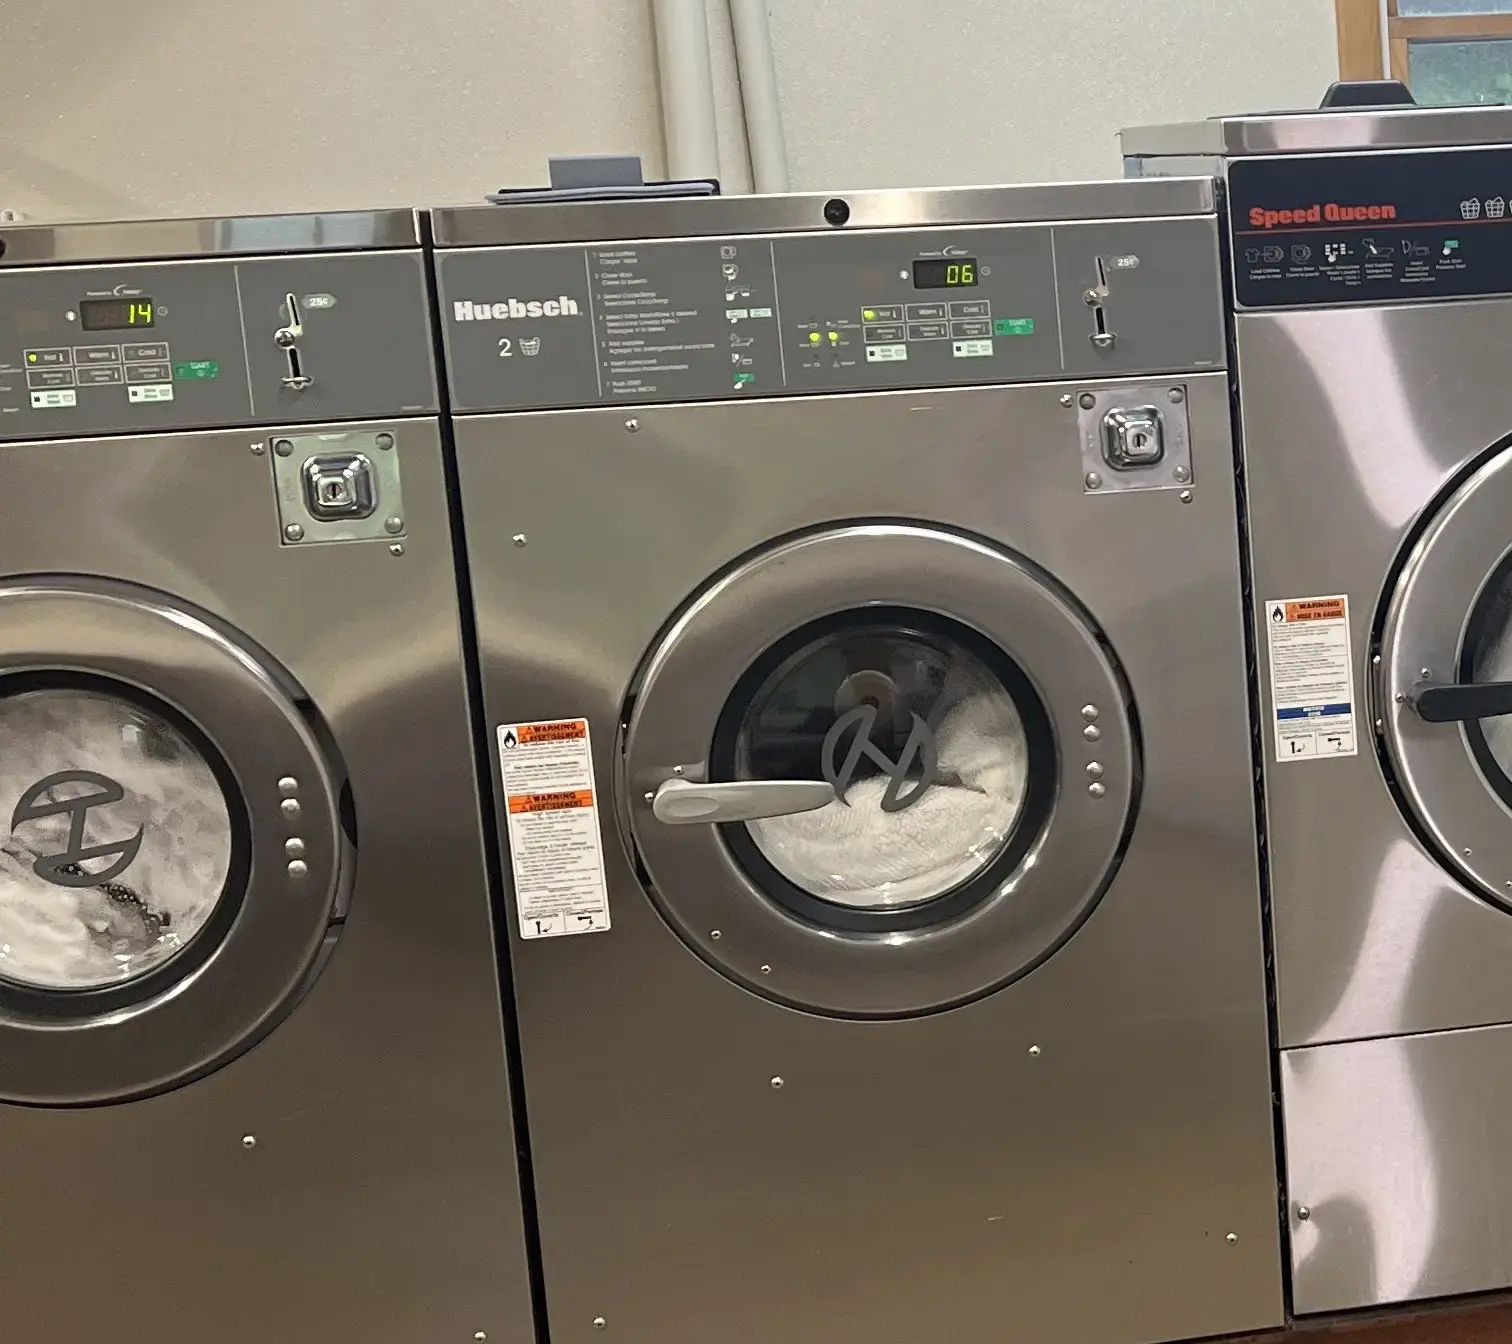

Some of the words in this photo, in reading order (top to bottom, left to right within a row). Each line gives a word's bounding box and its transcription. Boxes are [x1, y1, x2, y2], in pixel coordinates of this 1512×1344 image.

[1250, 205, 1320, 229] Speed
[1323, 202, 1396, 222] Queen
[946, 264, 973, 284] 06
[128, 304, 152, 324] 14
[453, 295, 579, 322] Huebsch
[498, 338, 513, 357] 2
[1299, 600, 1340, 610] WARNING
[533, 722, 577, 733] WARNING
[532, 791, 577, 802] WARNING
